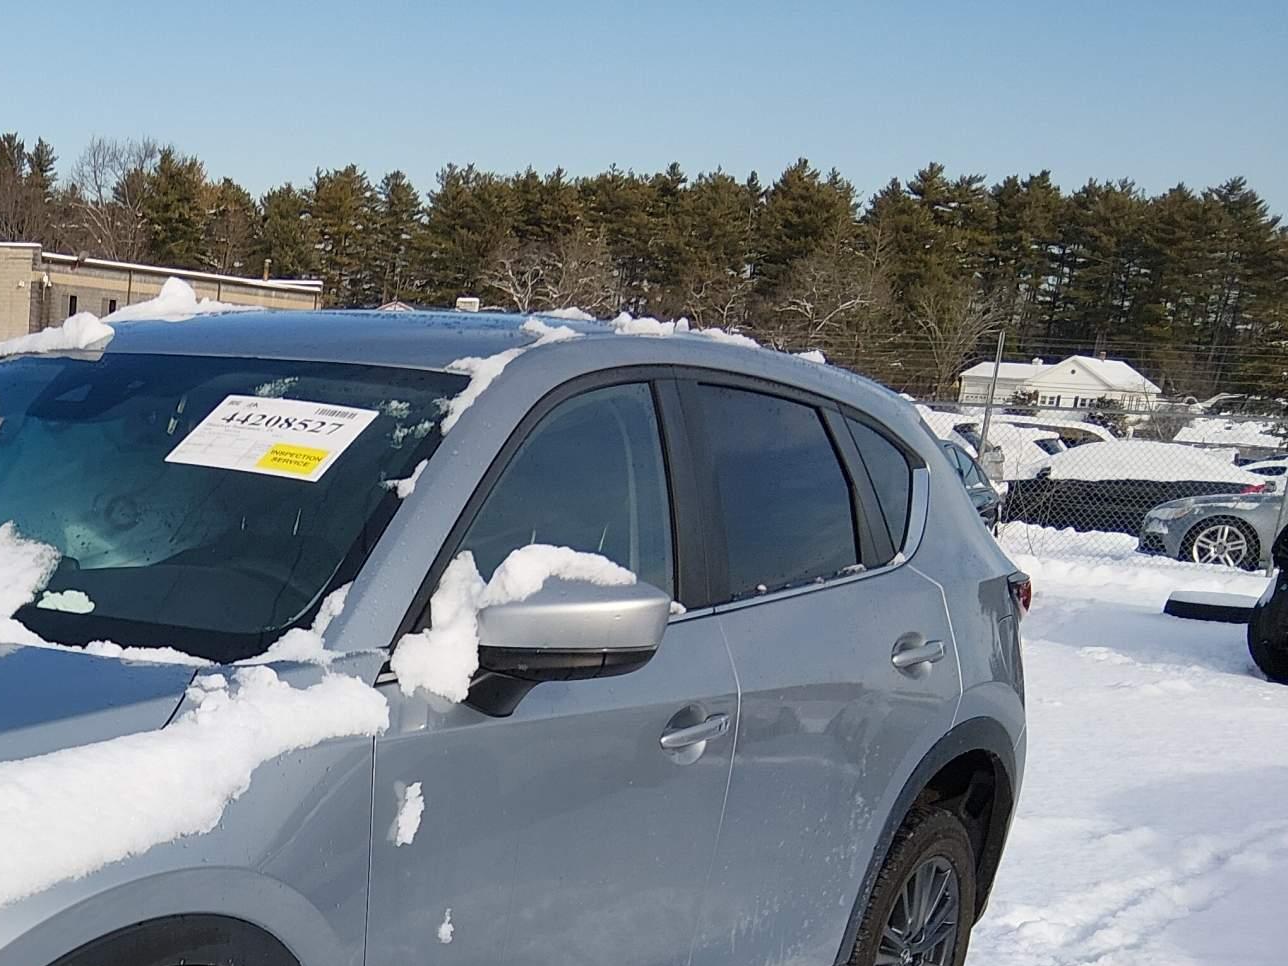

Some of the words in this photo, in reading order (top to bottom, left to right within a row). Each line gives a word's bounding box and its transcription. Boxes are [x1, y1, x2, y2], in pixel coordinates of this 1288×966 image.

[221, 411, 345, 435] 44208527
[270, 449, 323, 463] INSPECTION
[270, 456, 310, 467] SERVICE
